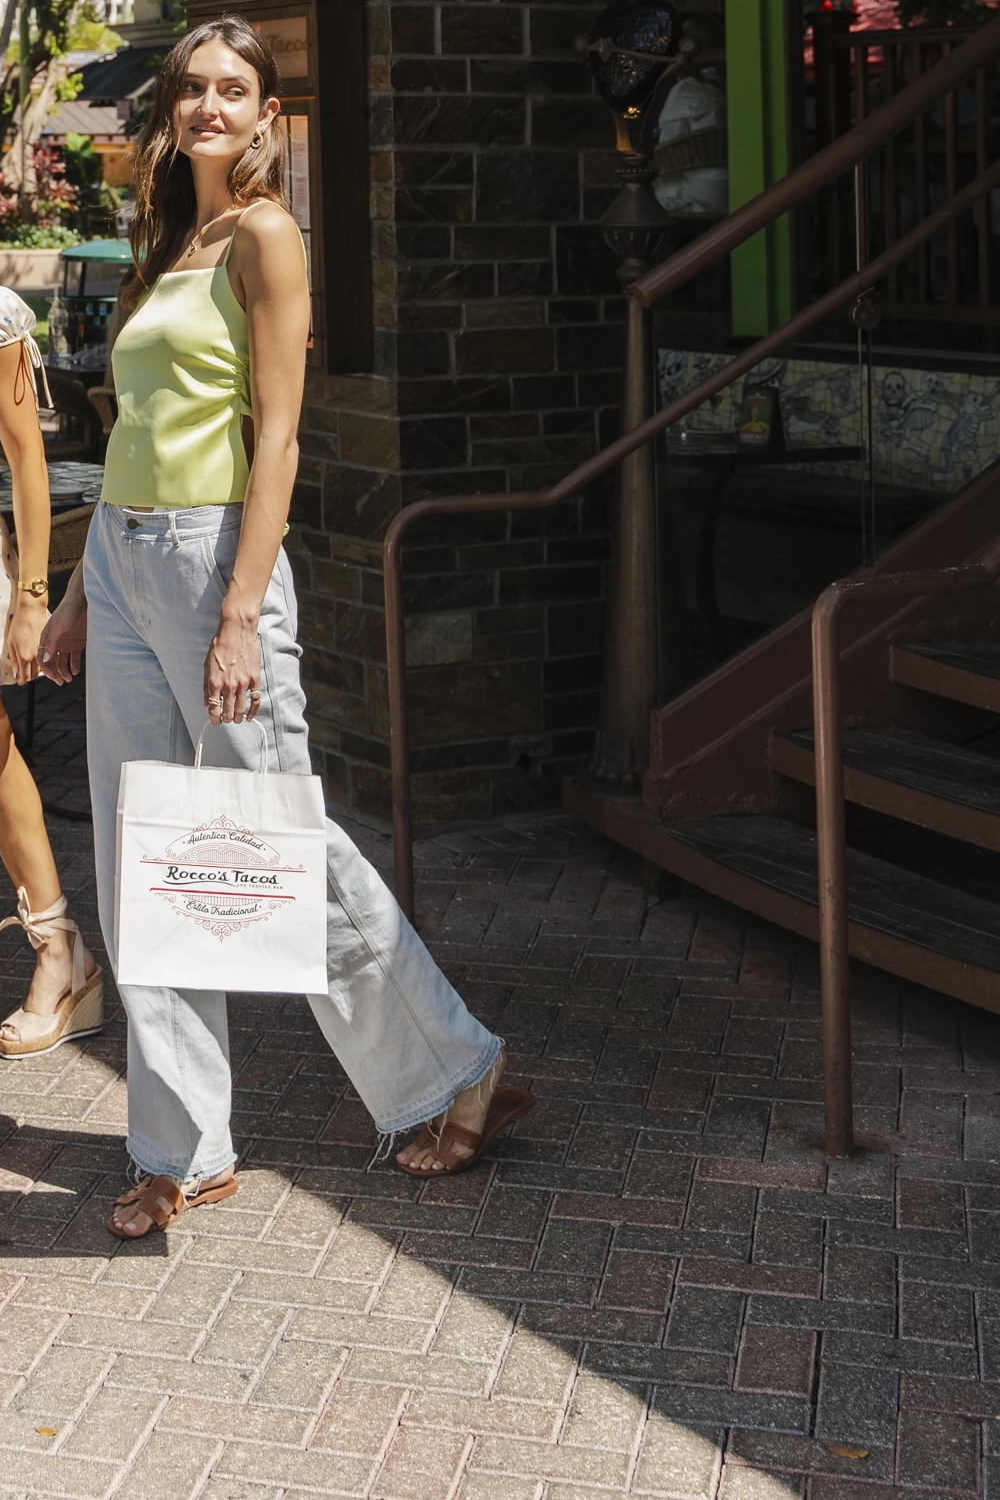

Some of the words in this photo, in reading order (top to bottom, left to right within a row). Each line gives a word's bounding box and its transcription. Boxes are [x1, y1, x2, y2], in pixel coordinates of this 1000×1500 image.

[228, 831, 264, 850] Calidad
[165, 865, 229, 881] Rocco's
[231, 869, 280, 885] Tacos
[186, 900, 209, 914] Estilo
[210, 903, 259, 916] Tradicional
